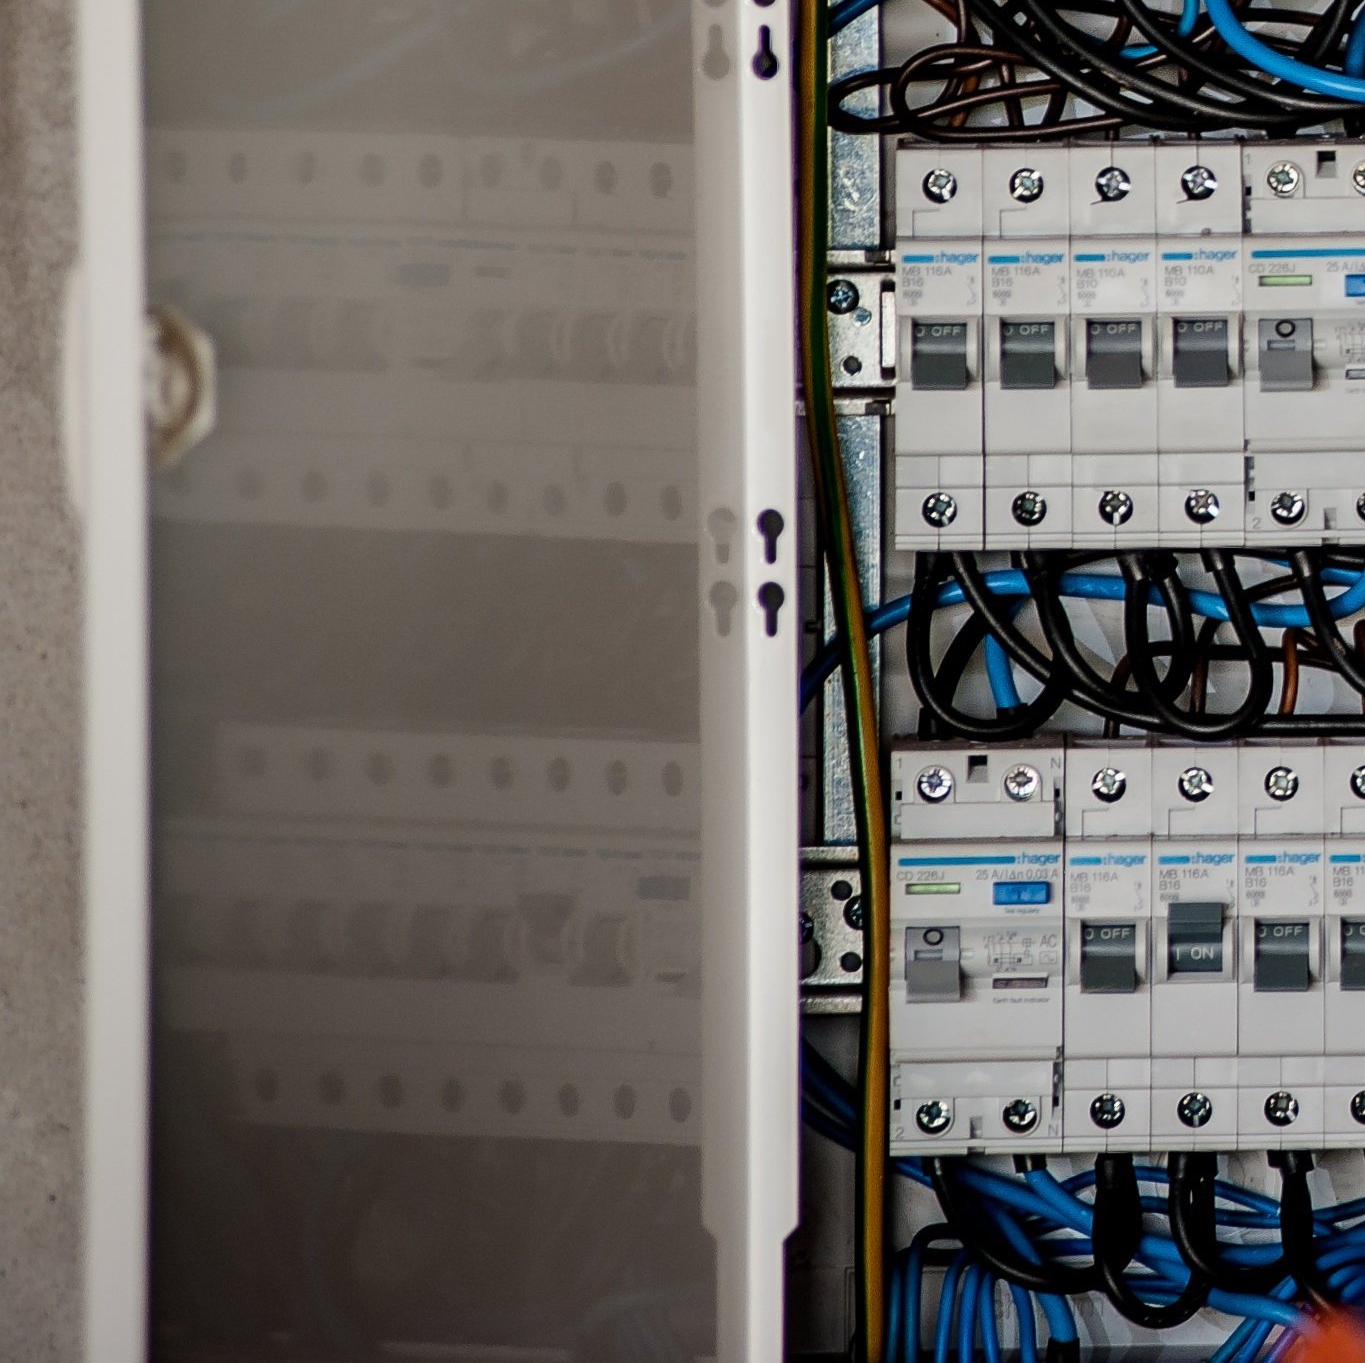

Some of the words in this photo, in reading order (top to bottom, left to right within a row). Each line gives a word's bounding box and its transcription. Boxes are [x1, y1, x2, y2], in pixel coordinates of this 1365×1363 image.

[976, 870, 989, 880] 25
[1159, 869, 1177, 879] MB
[1190, 947, 1214, 960] ON
